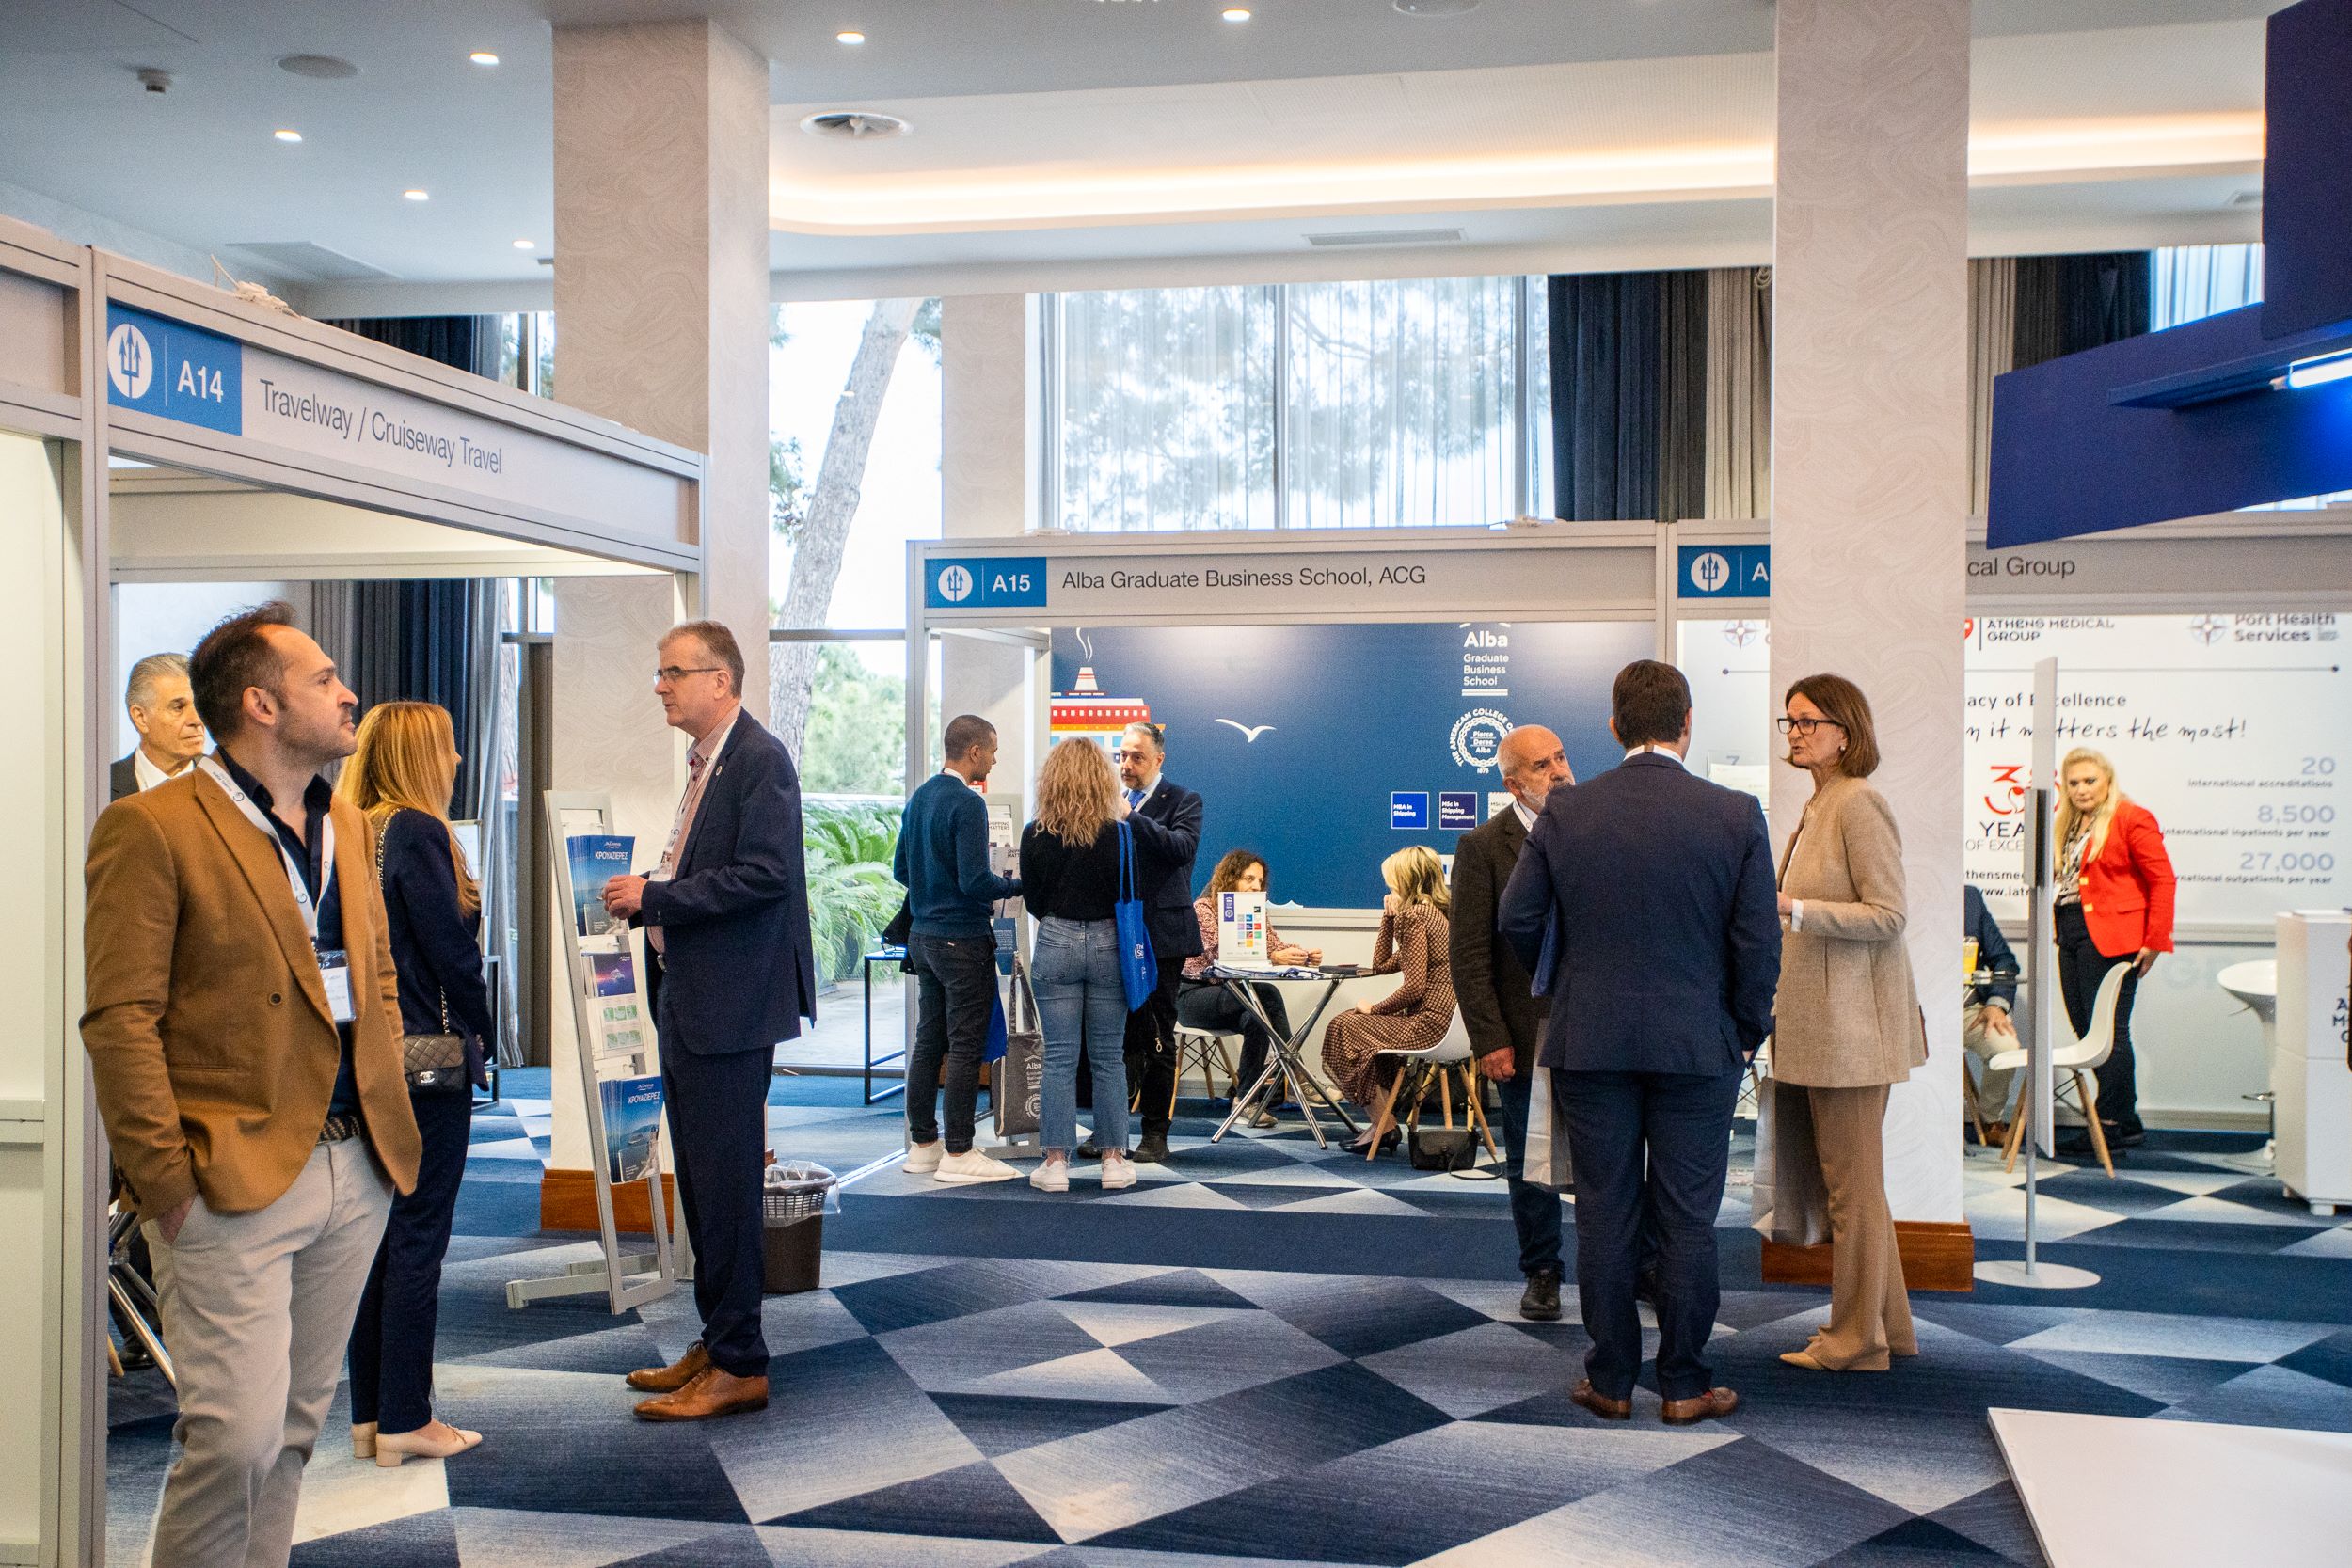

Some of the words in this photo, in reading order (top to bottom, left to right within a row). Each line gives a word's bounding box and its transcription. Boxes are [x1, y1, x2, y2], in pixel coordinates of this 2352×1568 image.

[177, 360, 224, 403] A14
[260, 378, 354, 440] Travelway
[358, 406, 367, 443] /
[372, 411, 455, 467] Cruiseway
[459, 436, 502, 475] Travel
[2006, 556, 2075, 579] Group
[992, 574, 1031, 593] A15
[1062, 571, 1104, 589] Alba
[1110, 570, 1200, 589] Graduate
[1205, 569, 1294, 588] Business
[1299, 566, 1373, 588] School,
[1379, 565, 1426, 585] ACG
[1987, 618, 2045, 629] ATHENS
[2049, 617, 2115, 629] MEDICAL
[2235, 613, 2272, 626] Port
[2277, 612, 2336, 626] Health
[1463, 630, 1508, 647] Alba
[1987, 631, 2041, 641] GROUP
[2234, 628, 2311, 642] Services
[1463, 653, 1510, 663] Graduate
[1463, 664, 1506, 674] Business
[1463, 675, 1498, 686] School
[2005, 692, 2022, 706] of
[1472, 707, 1509, 724] COLLEGE
[1450, 711, 1472, 751] AMERICAN
[1989, 716, 2010, 736] it
[2018, 716, 2118, 739] mtters
[2128, 716, 2168, 741] the
[2178, 716, 2247, 742] most!
[1452, 751, 1464, 767] THE
[2301, 756, 2336, 775] 20
[2188, 778, 2255, 787] international
[2258, 778, 2334, 788] accreditations
[2256, 804, 2336, 825] 8,500
[1979, 821, 2025, 838] YEA
[2231, 827, 2284, 838] inpatients
[2286, 829, 2303, 838] per
[2308, 829, 2331, 838] year
[1965, 839, 1983, 852] OF
[2240, 851, 2335, 872] 27,000
[2225, 874, 2284, 885] outpatients
[2288, 876, 2305, 886] per
[2310, 876, 2332, 886] year
